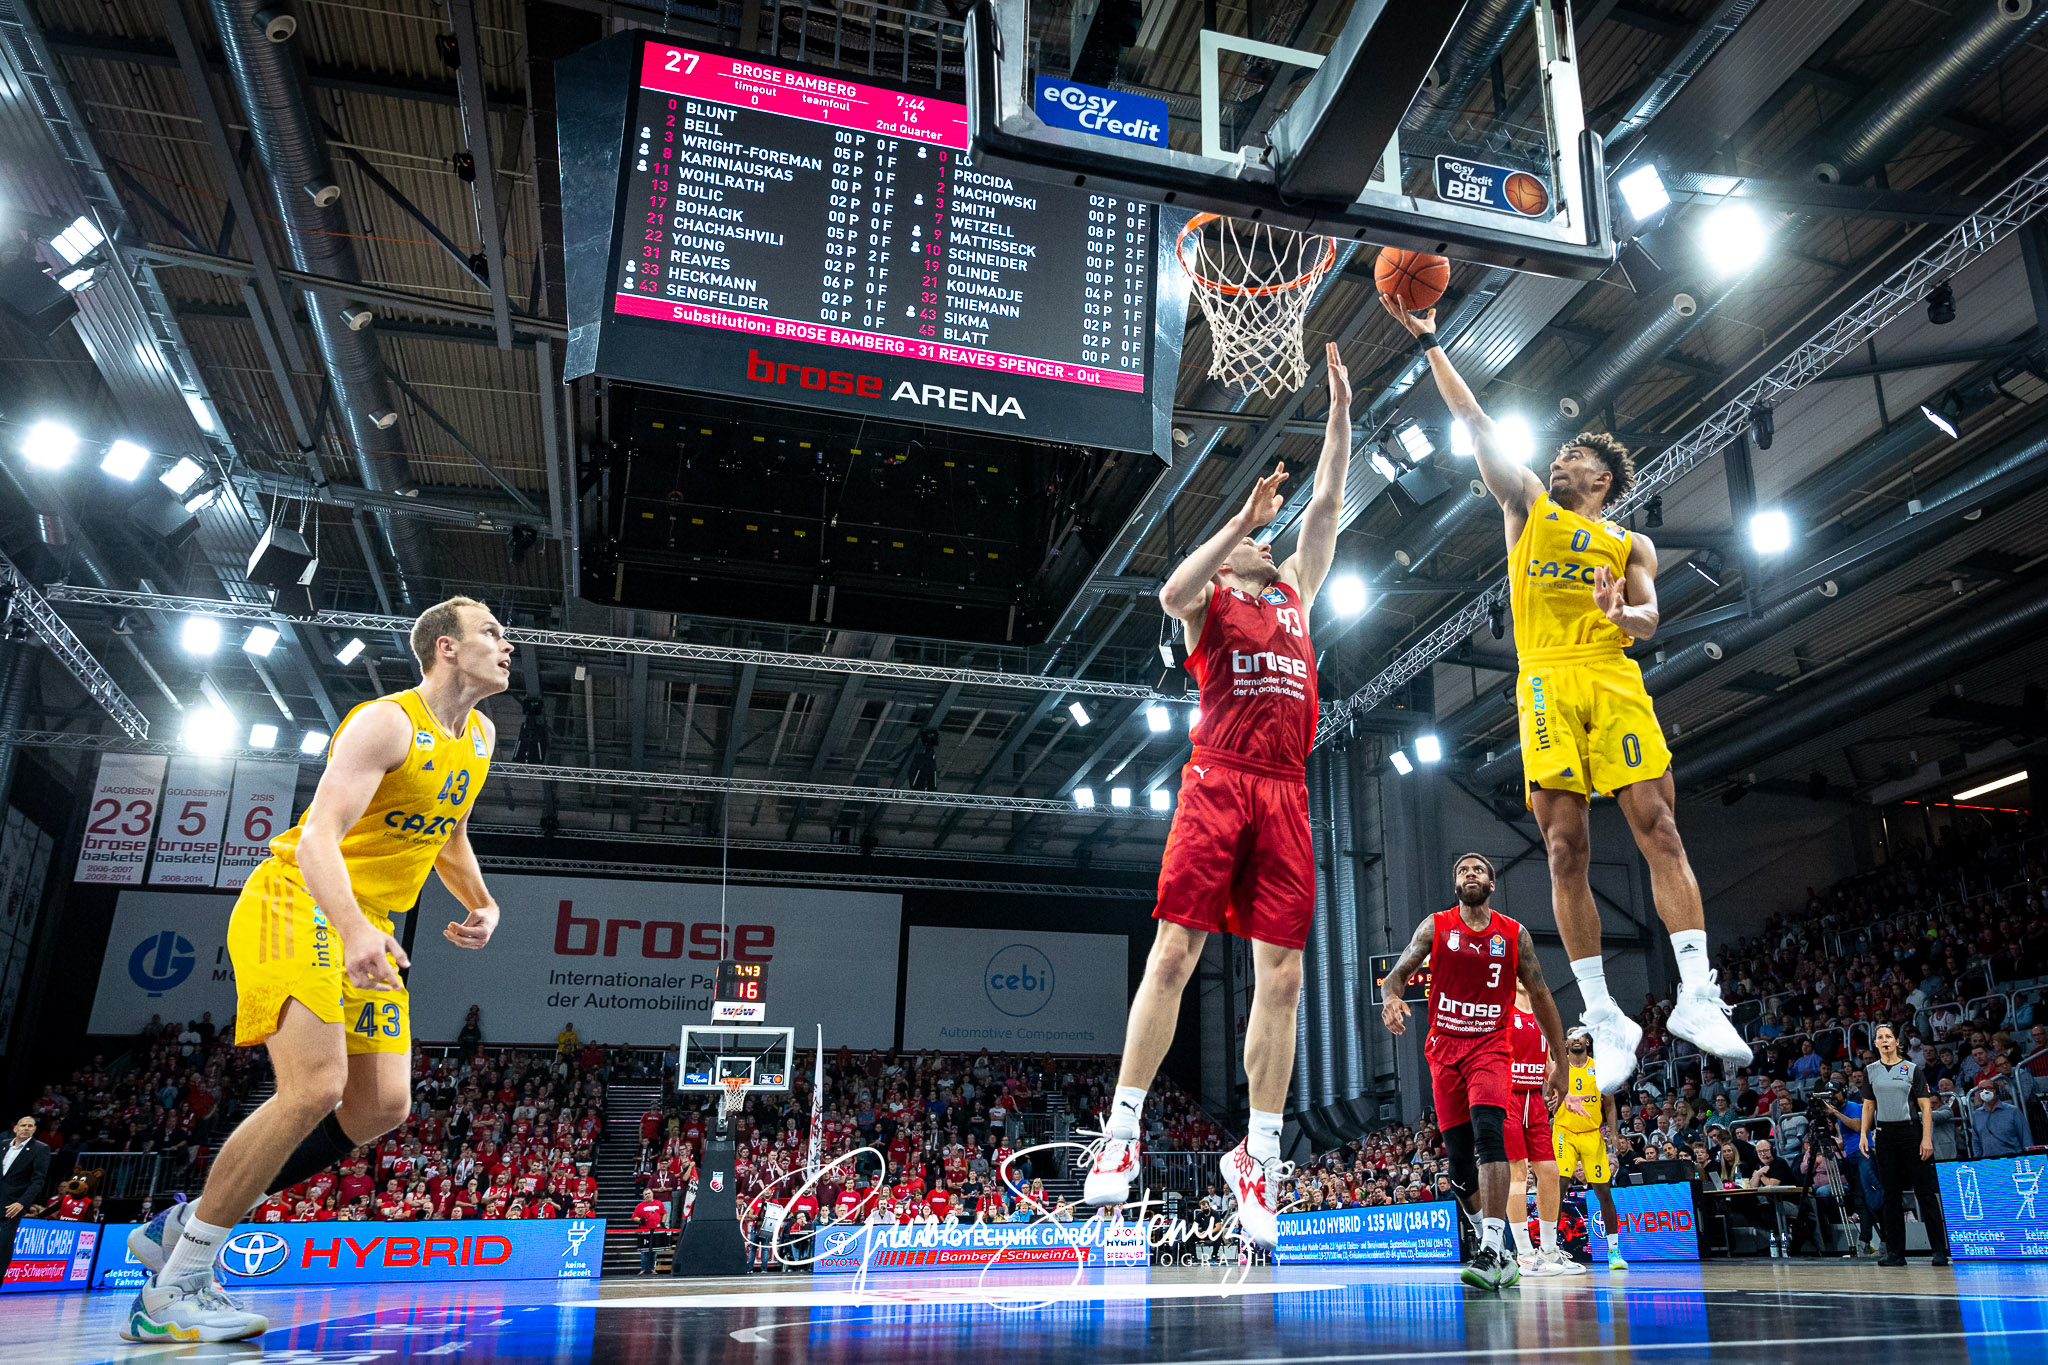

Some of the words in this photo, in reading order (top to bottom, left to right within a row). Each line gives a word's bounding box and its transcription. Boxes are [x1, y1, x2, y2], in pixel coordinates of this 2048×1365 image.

[664, 50, 700, 75] 27
[732, 62, 782, 83] BROSE
[784, 72, 857, 98] BAMBERG
[734, 80, 777, 97] timeout
[802, 93, 850, 112] teamfoul
[750, 94, 759, 105] 0
[822, 108, 828, 119] 1
[896, 95, 926, 112] 7:44
[667, 98, 678, 111] 0
[686, 101, 738, 122] BLUNT
[902, 110, 918, 124] 16
[665, 114, 676, 127] 2
[684, 117, 724, 137] BELL
[876, 119, 897, 132] 2nd
[899, 123, 943, 141] Quarter
[1079, 109, 1160, 141] Credit
[664, 130, 674, 143] 3
[682, 133, 822, 171] WRIGHT-FOREMAN
[938, 150, 948, 163] 0
[662, 147, 672, 160] 8
[680, 150, 793, 182] KARINIAUSKAS
[651, 178, 669, 192] 13
[677, 183, 724, 202] BULIC
[652, 162, 669, 176] 11
[678, 166, 765, 193] WOHLRATH
[938, 166, 945, 178] 1
[954, 168, 1014, 191] PROCIDA
[1459, 172, 1493, 187] Credit
[936, 181, 946, 194] 2
[953, 184, 1037, 211] MACHOWSKI
[1447, 180, 1494, 204] BBL
[649, 195, 668, 209] 17
[675, 199, 744, 223] BOHACIK
[935, 197, 944, 209] 3
[951, 200, 996, 219] SMITH
[646, 211, 664, 226] 21
[673, 216, 784, 246] CHACHASHVILI
[934, 212, 944, 225] 7
[950, 215, 1015, 238] WETZELL
[644, 228, 664, 243] 22
[671, 232, 726, 253] YOUNG
[933, 228, 942, 241] 9
[949, 231, 1037, 258] MATTISSECK
[642, 245, 660, 259] 31
[670, 249, 731, 271] REAVES
[925, 243, 942, 257] 10
[948, 247, 1028, 272] SCHNEIDER
[640, 261, 660, 276] 33
[668, 266, 757, 292] HECKMANN
[924, 259, 941, 272] 19
[947, 263, 1000, 283] OLINDE
[638, 279, 658, 293] 43
[665, 283, 769, 311] SENGFELDER
[921, 275, 938, 289] 21
[946, 279, 1024, 303] KOUMADJE
[921, 291, 938, 305] 32
[945, 294, 1020, 319] THIEMANN
[919, 307, 937, 321] 43
[943, 311, 990, 330] SIKMA
[672, 306, 771, 333] Substitution:
[774, 321, 827, 342] BROSE
[830, 330, 905, 353] BAMBERG
[918, 344, 934, 358] 31
[938, 347, 996, 367] REAVES
[998, 356, 1065, 378] SPENCER
[1077, 369, 1101, 384] Out
[918, 323, 936, 337] 45
[943, 327, 989, 346] BLATT
[747, 349, 883, 398] brose
[890, 381, 1026, 420] ARENA
[1570, 529, 1591, 552] 0
[1276, 607, 1303, 638] 43
[1232, 649, 1307, 679] brose
[1532, 676, 1551, 751] interzero
[1622, 733, 1642, 768] 0
[100, 786, 155, 795] JACOBSEN
[167, 788, 228, 797] GOLDSBERRY
[250, 794, 275, 802] ZISIS
[437, 769, 470, 805] 43
[88, 798, 152, 836] 23
[177, 801, 208, 836] 5
[244, 806, 274, 842] 6
[84, 835, 147, 851] brose
[157, 837, 218, 852] brose
[224, 842, 272, 857] bros
[81, 850, 144, 862] baskets
[155, 852, 216, 864] baskets
[554, 900, 775, 962] brose
[549, 969, 686, 988] Internationaler
[691, 974, 714, 989] Pa
[991, 964, 1045, 991] cebi
[1487, 963, 1502, 988] 3
[547, 992, 580, 1008] der
[584, 993, 713, 1011] Automobilind
[738, 981, 759, 999] 16
[1438, 992, 1502, 1018] brose
[354, 1002, 400, 1037] 43
[938, 1027, 1013, 1039] Automotive
[1017, 1028, 1095, 1041] Components
[1575, 1078, 1583, 1091] 3
[1595, 1165, 1602, 1178] 3
[1277, 1218, 1312, 1237] COROLLA
[1312, 1217, 1326, 1234] 2.0
[1327, 1215, 1361, 1233] HYBRID
[1367, 1213, 1385, 1232] 135
[1386, 1212, 1402, 1231] kW
[1404, 1210, 1429, 1233] (184
[1431, 1209, 1451, 1232] PS)
[1616, 1210, 1693, 1234] HYBRID
[47, 1229, 75, 1255] GMBH
[1950, 1229, 2006, 1242] elektrisches
[300, 1236, 513, 1269] HYBRID
[940, 1249, 1086, 1263] Bamberg-Schweinfurt
[1964, 1244, 1996, 1256] Fahren
[115, 1278, 145, 1286] Fahren
[558, 1269, 591, 1277] Ladezeit
